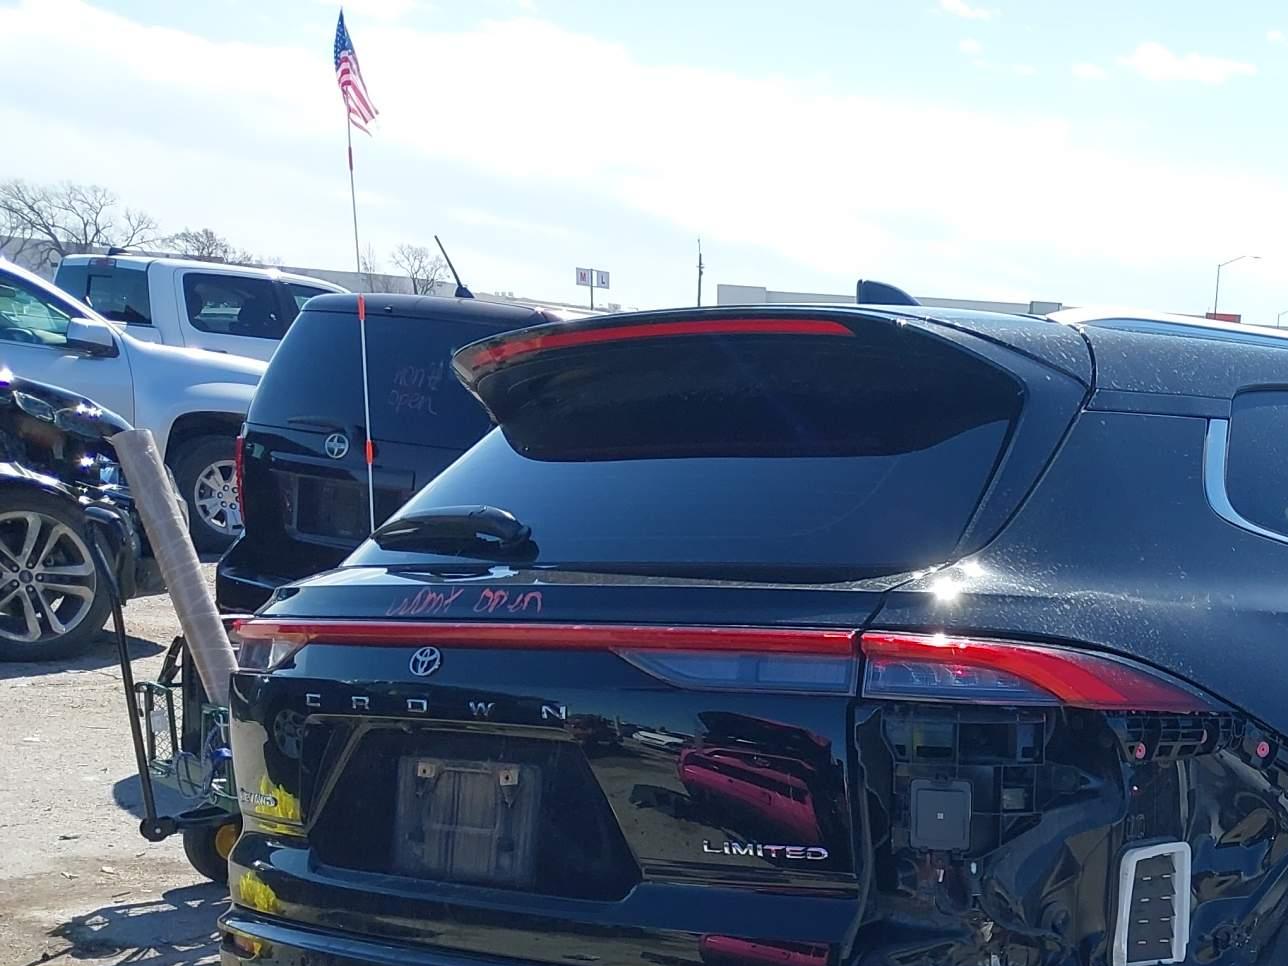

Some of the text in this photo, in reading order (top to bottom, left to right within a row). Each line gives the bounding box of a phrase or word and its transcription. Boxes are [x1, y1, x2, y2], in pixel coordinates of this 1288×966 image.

[601, 274, 606, 285] L
[306, 692, 567, 720] CROWN
[703, 840, 829, 860] LIMITED
